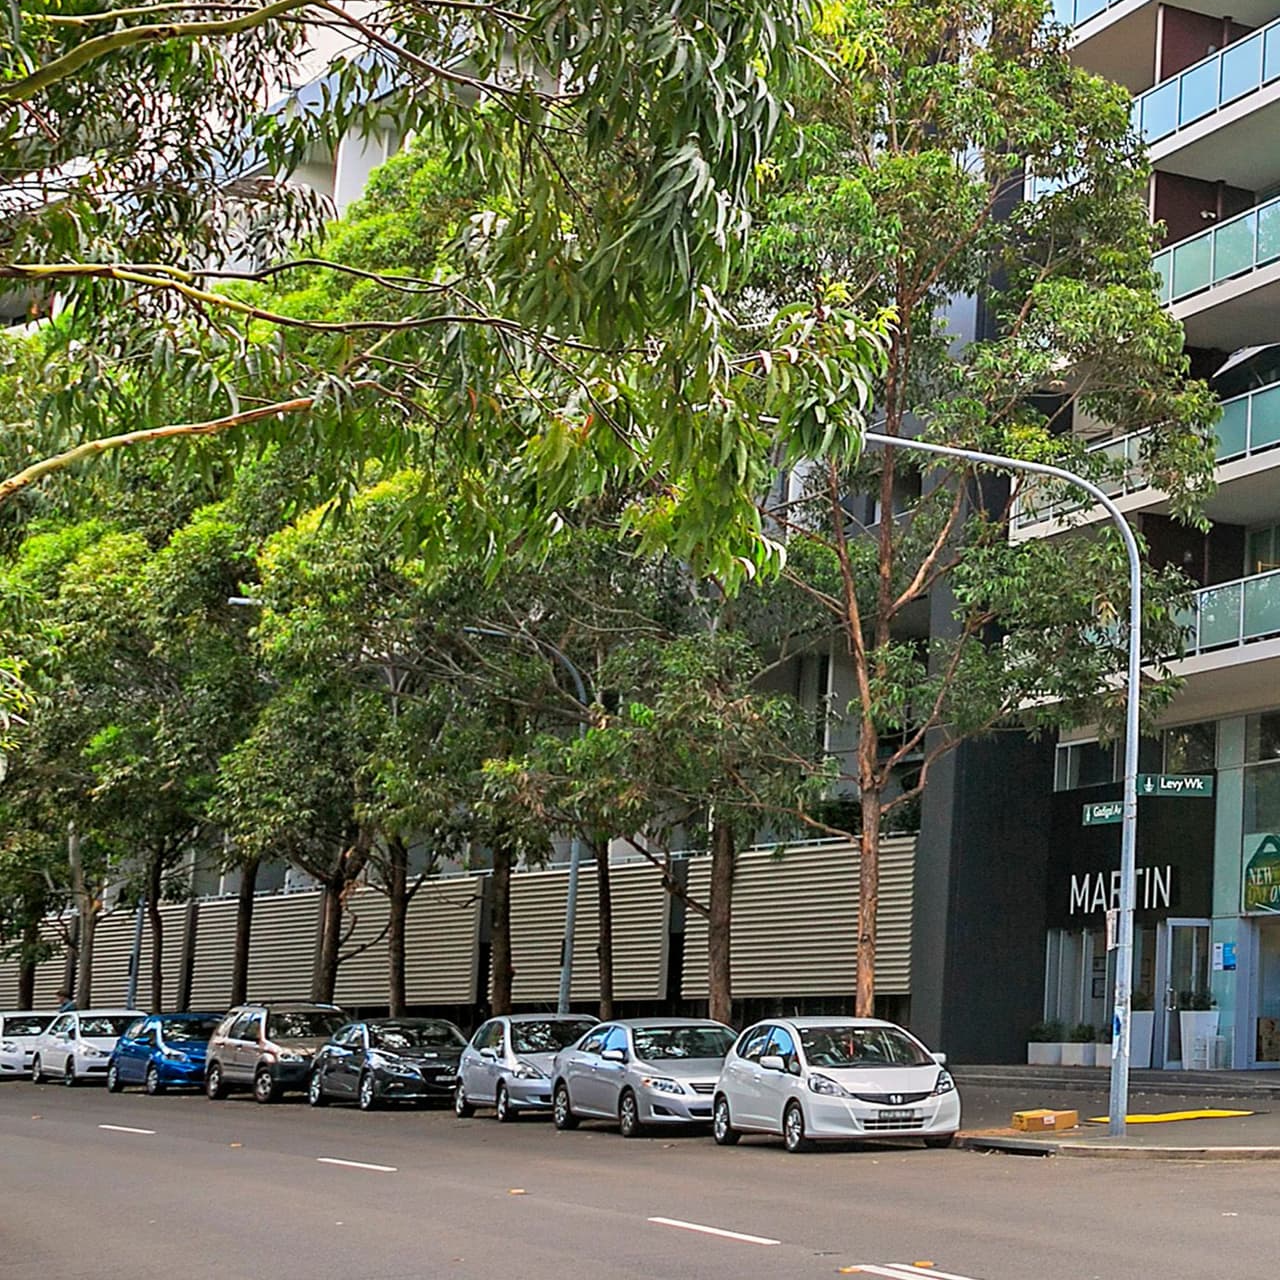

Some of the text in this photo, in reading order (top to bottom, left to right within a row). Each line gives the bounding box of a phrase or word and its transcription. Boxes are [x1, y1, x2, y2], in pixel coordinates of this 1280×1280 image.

[1160, 777, 1204, 792] Levy Wk
[1247, 866, 1273, 885] NEW
